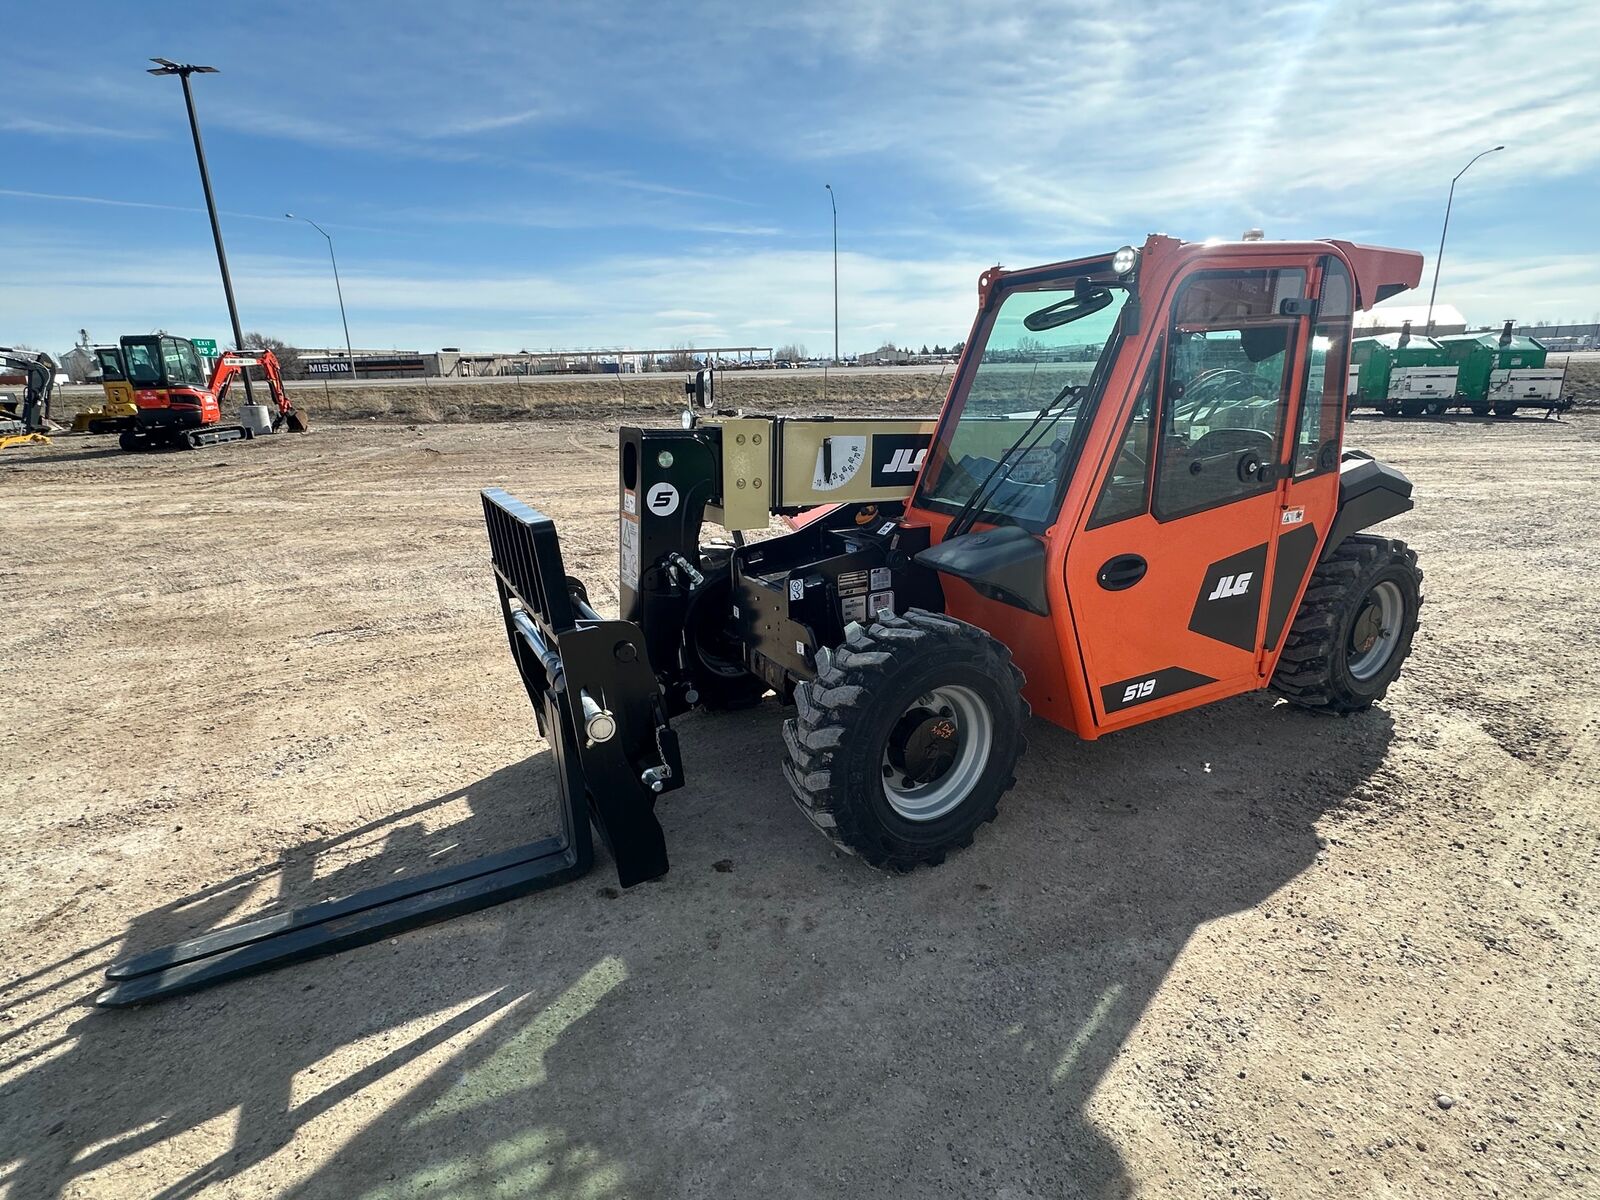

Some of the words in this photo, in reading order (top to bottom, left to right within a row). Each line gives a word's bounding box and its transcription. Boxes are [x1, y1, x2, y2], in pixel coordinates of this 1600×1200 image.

[308, 363, 349, 373] MISKIN
[1208, 571, 1254, 601] JLG
[1121, 678, 1157, 703] 519
